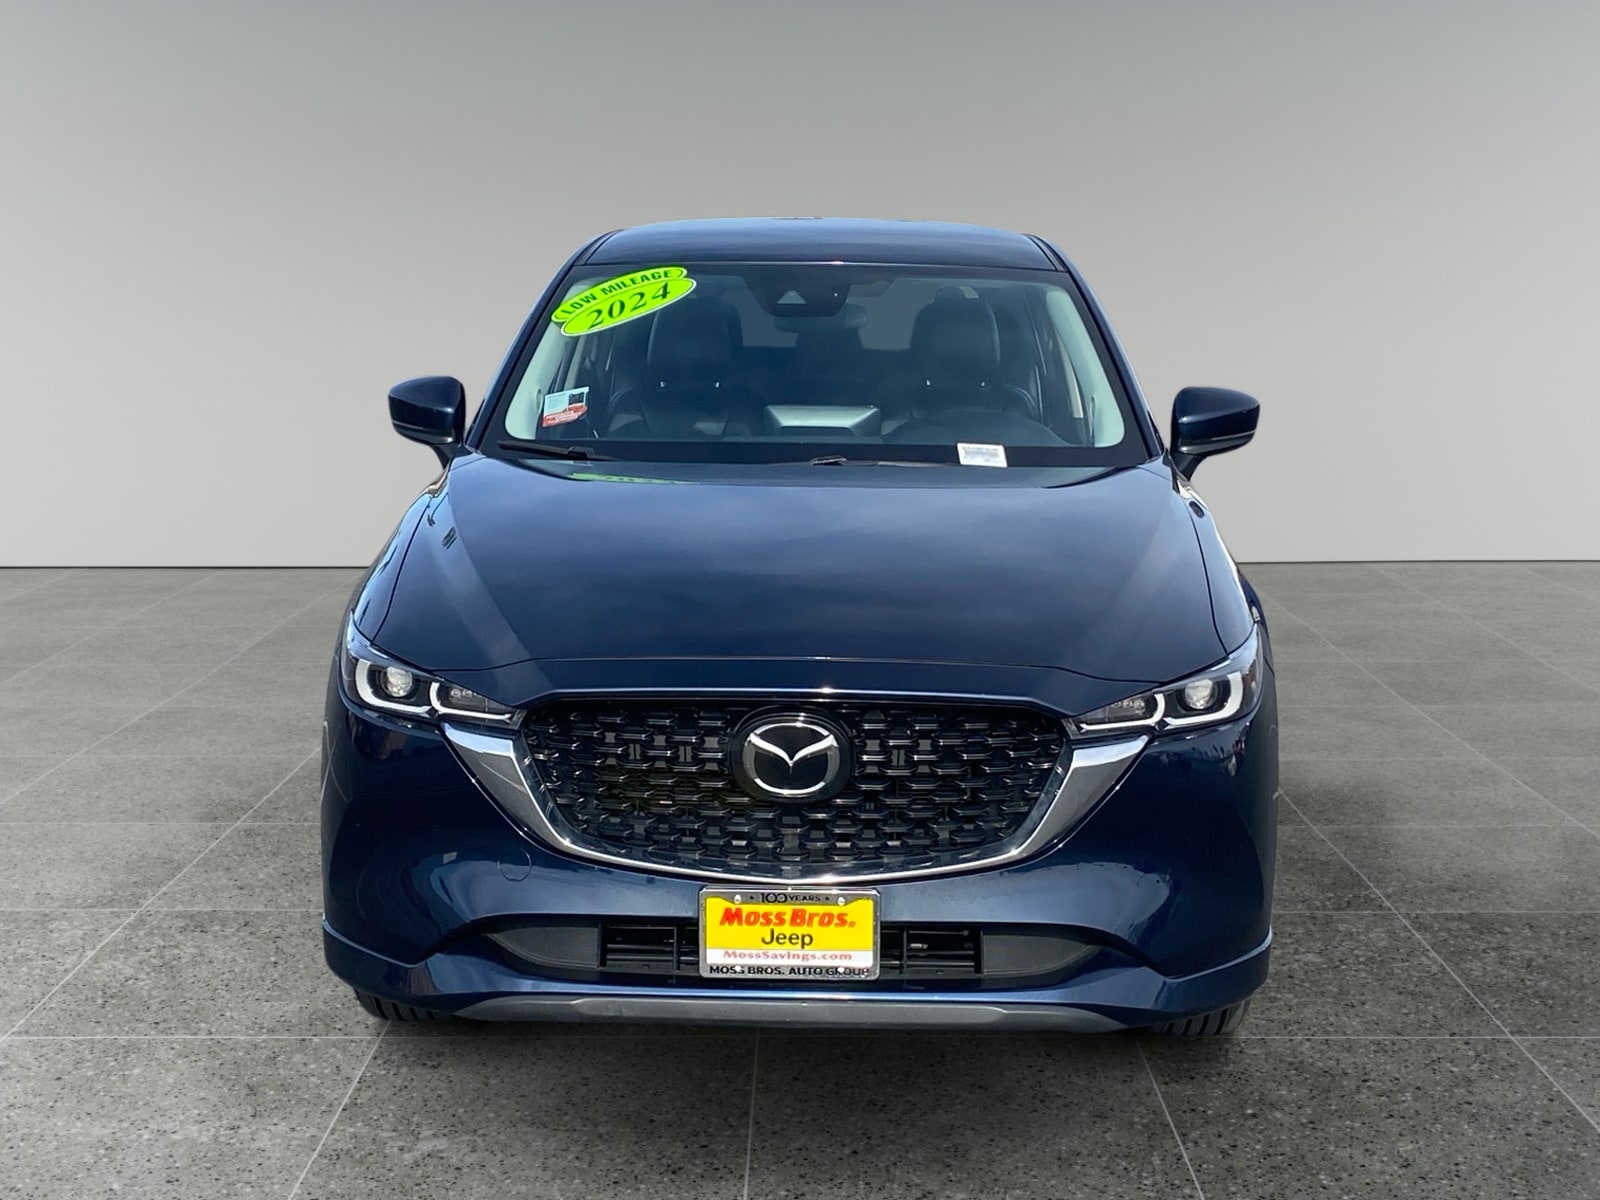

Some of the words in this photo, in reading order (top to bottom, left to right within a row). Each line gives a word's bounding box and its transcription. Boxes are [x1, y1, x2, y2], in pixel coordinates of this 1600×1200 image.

[561, 293, 598, 315] LOW
[600, 269, 673, 296] MILEAGE
[586, 281, 670, 330] 2024
[788, 894, 821, 903] YEARS
[719, 907, 786, 928] Moss
[789, 908, 856, 928] Bros.
[761, 928, 814, 949] Jeep
[723, 949, 853, 962] MossSavings.com
[709, 966, 745, 976] MOSS
[747, 966, 785, 976] BROS.
[788, 966, 823, 976] AUTO
